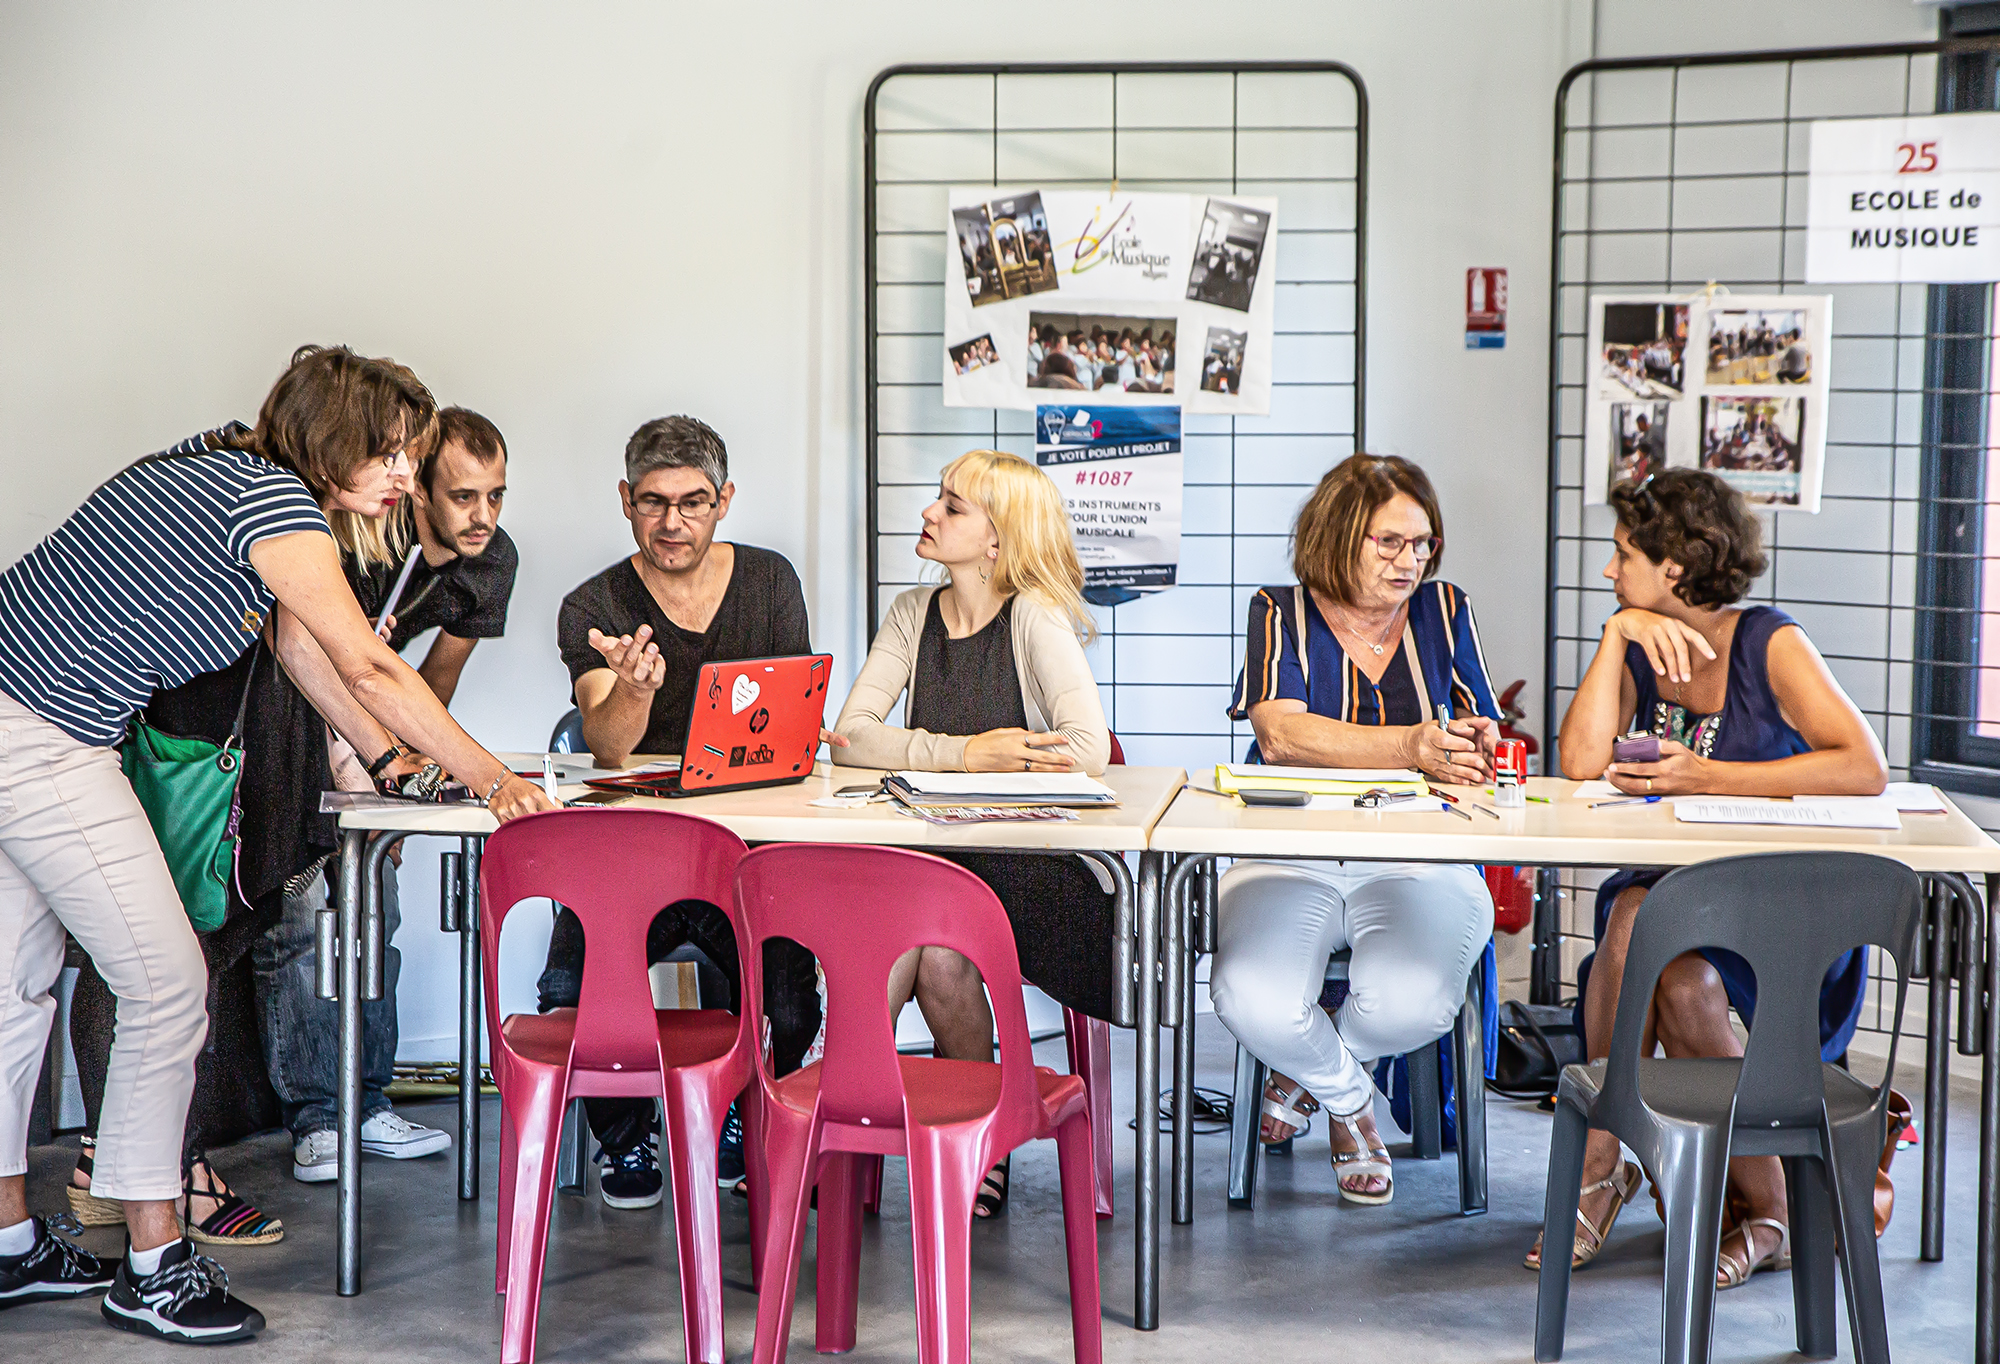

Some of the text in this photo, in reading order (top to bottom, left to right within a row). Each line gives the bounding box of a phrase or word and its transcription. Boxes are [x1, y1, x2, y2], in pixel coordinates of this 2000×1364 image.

[1897, 141, 1938, 173] 25
[1850, 188, 1982, 211] ECOLE de
[1851, 226, 1979, 249] MUSIQUE
[1110, 247, 1170, 273] Musique
[1046, 441, 1170, 463] JE VOTE POUR LE PROJET
[1075, 470, 1133, 486] #1087
[1079, 500, 1161, 512] INSTRUMENTS
[1101, 514, 1147, 525] L'UNION
[1076, 527, 1135, 539] MUSICALE
